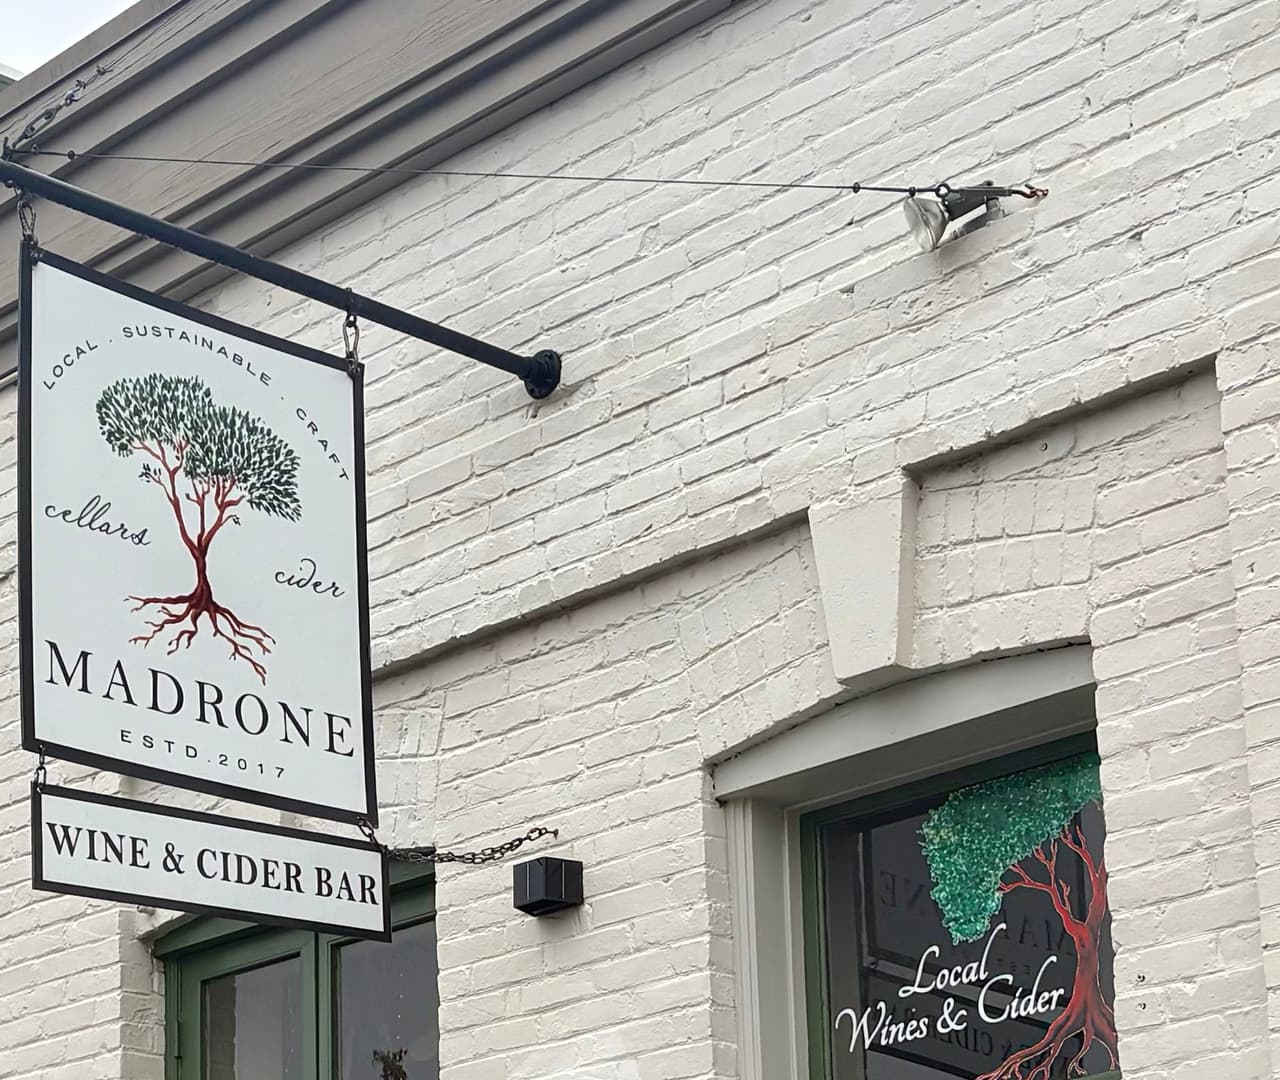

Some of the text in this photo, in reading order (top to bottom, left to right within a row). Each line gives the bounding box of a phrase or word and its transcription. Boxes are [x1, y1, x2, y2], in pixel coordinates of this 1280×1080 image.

[43, 325, 349, 481] LOCAL SUSTAINABLE CRAFT
[45, 495, 151, 546] cellars
[274, 558, 345, 597] cider
[45, 639, 355, 758] MADRONE
[46, 822, 380, 905] WINE & CIDER BAR
[898, 923, 1008, 998] Local
[834, 1001, 930, 1053] Wines
[936, 997, 968, 1034] &
[977, 955, 1066, 1024] Cider
